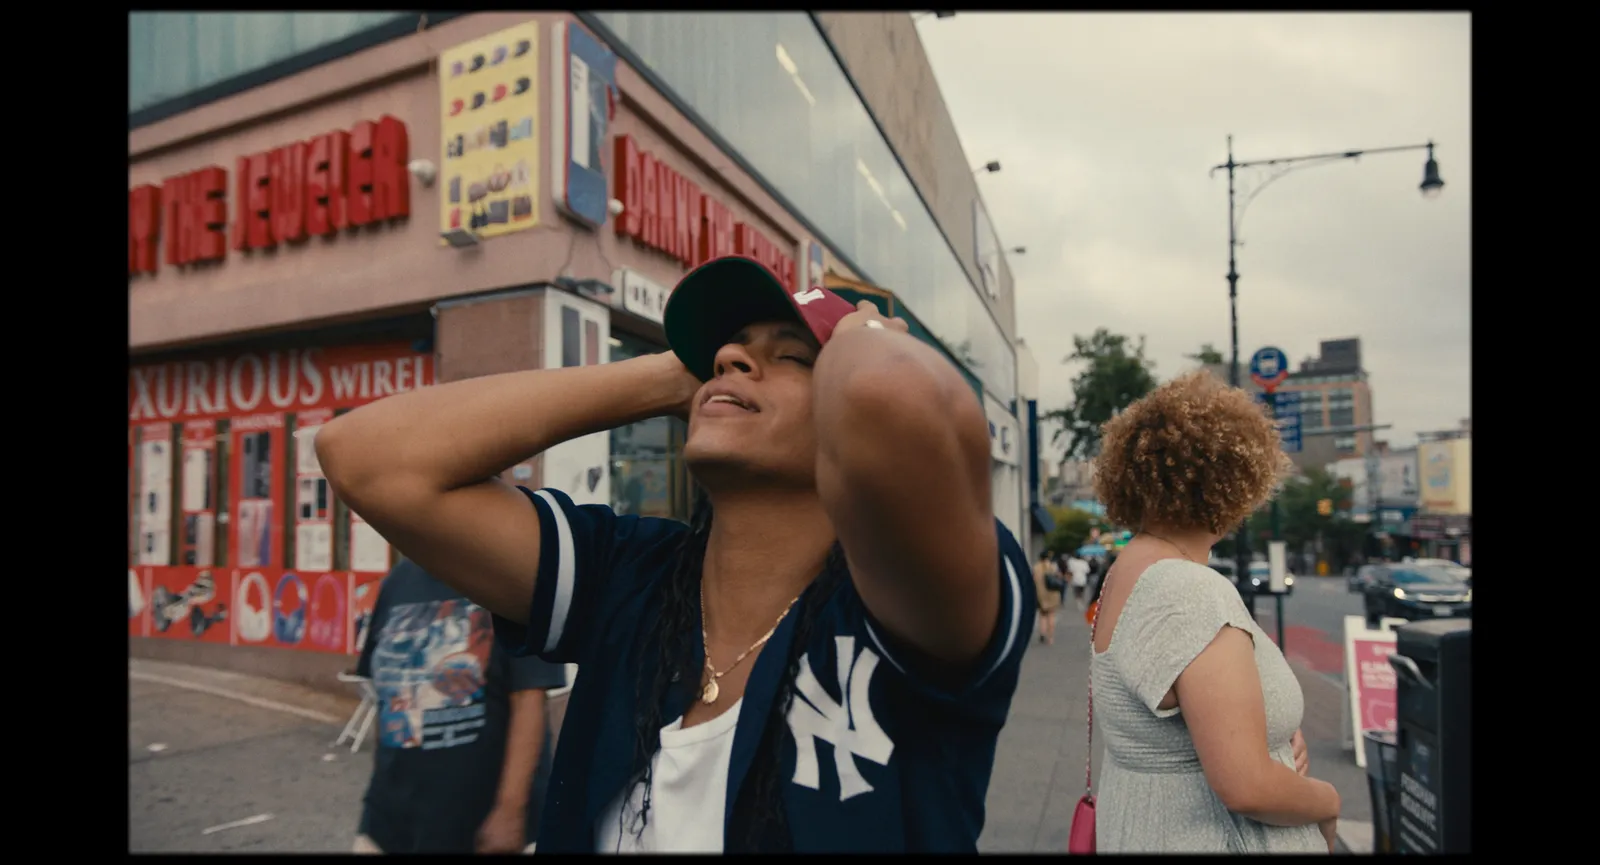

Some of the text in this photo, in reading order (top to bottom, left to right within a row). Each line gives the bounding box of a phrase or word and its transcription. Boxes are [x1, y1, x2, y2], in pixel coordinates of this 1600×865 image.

[162, 166, 227, 265] THE
[232, 114, 410, 251] JEWELER
[614, 134, 701, 268] DANNY
[129, 350, 324, 420] XURIOUS
[785, 635, 895, 802] NY
